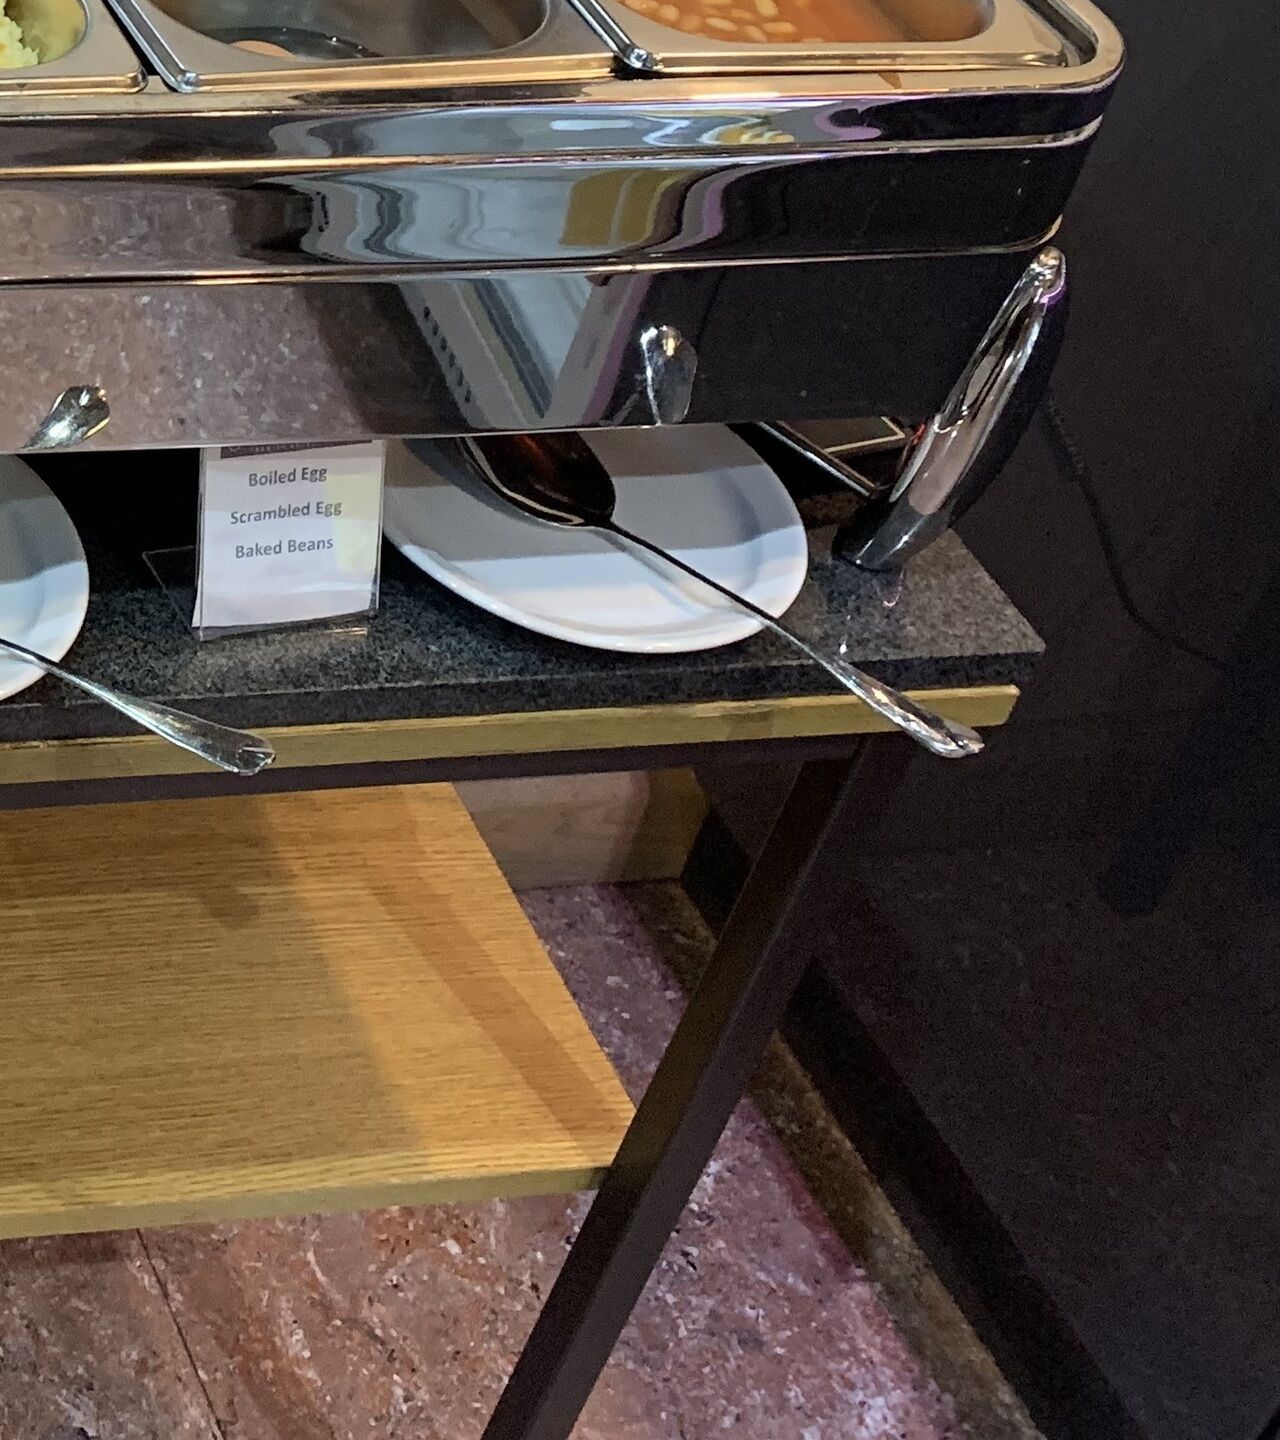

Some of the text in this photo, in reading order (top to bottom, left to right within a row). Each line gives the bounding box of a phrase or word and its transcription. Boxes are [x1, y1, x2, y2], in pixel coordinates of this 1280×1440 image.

[249, 467, 327, 486] Boiled Egg
[230, 501, 342, 524] Scrambled Egg
[236, 539, 333, 558] Baked Beans
